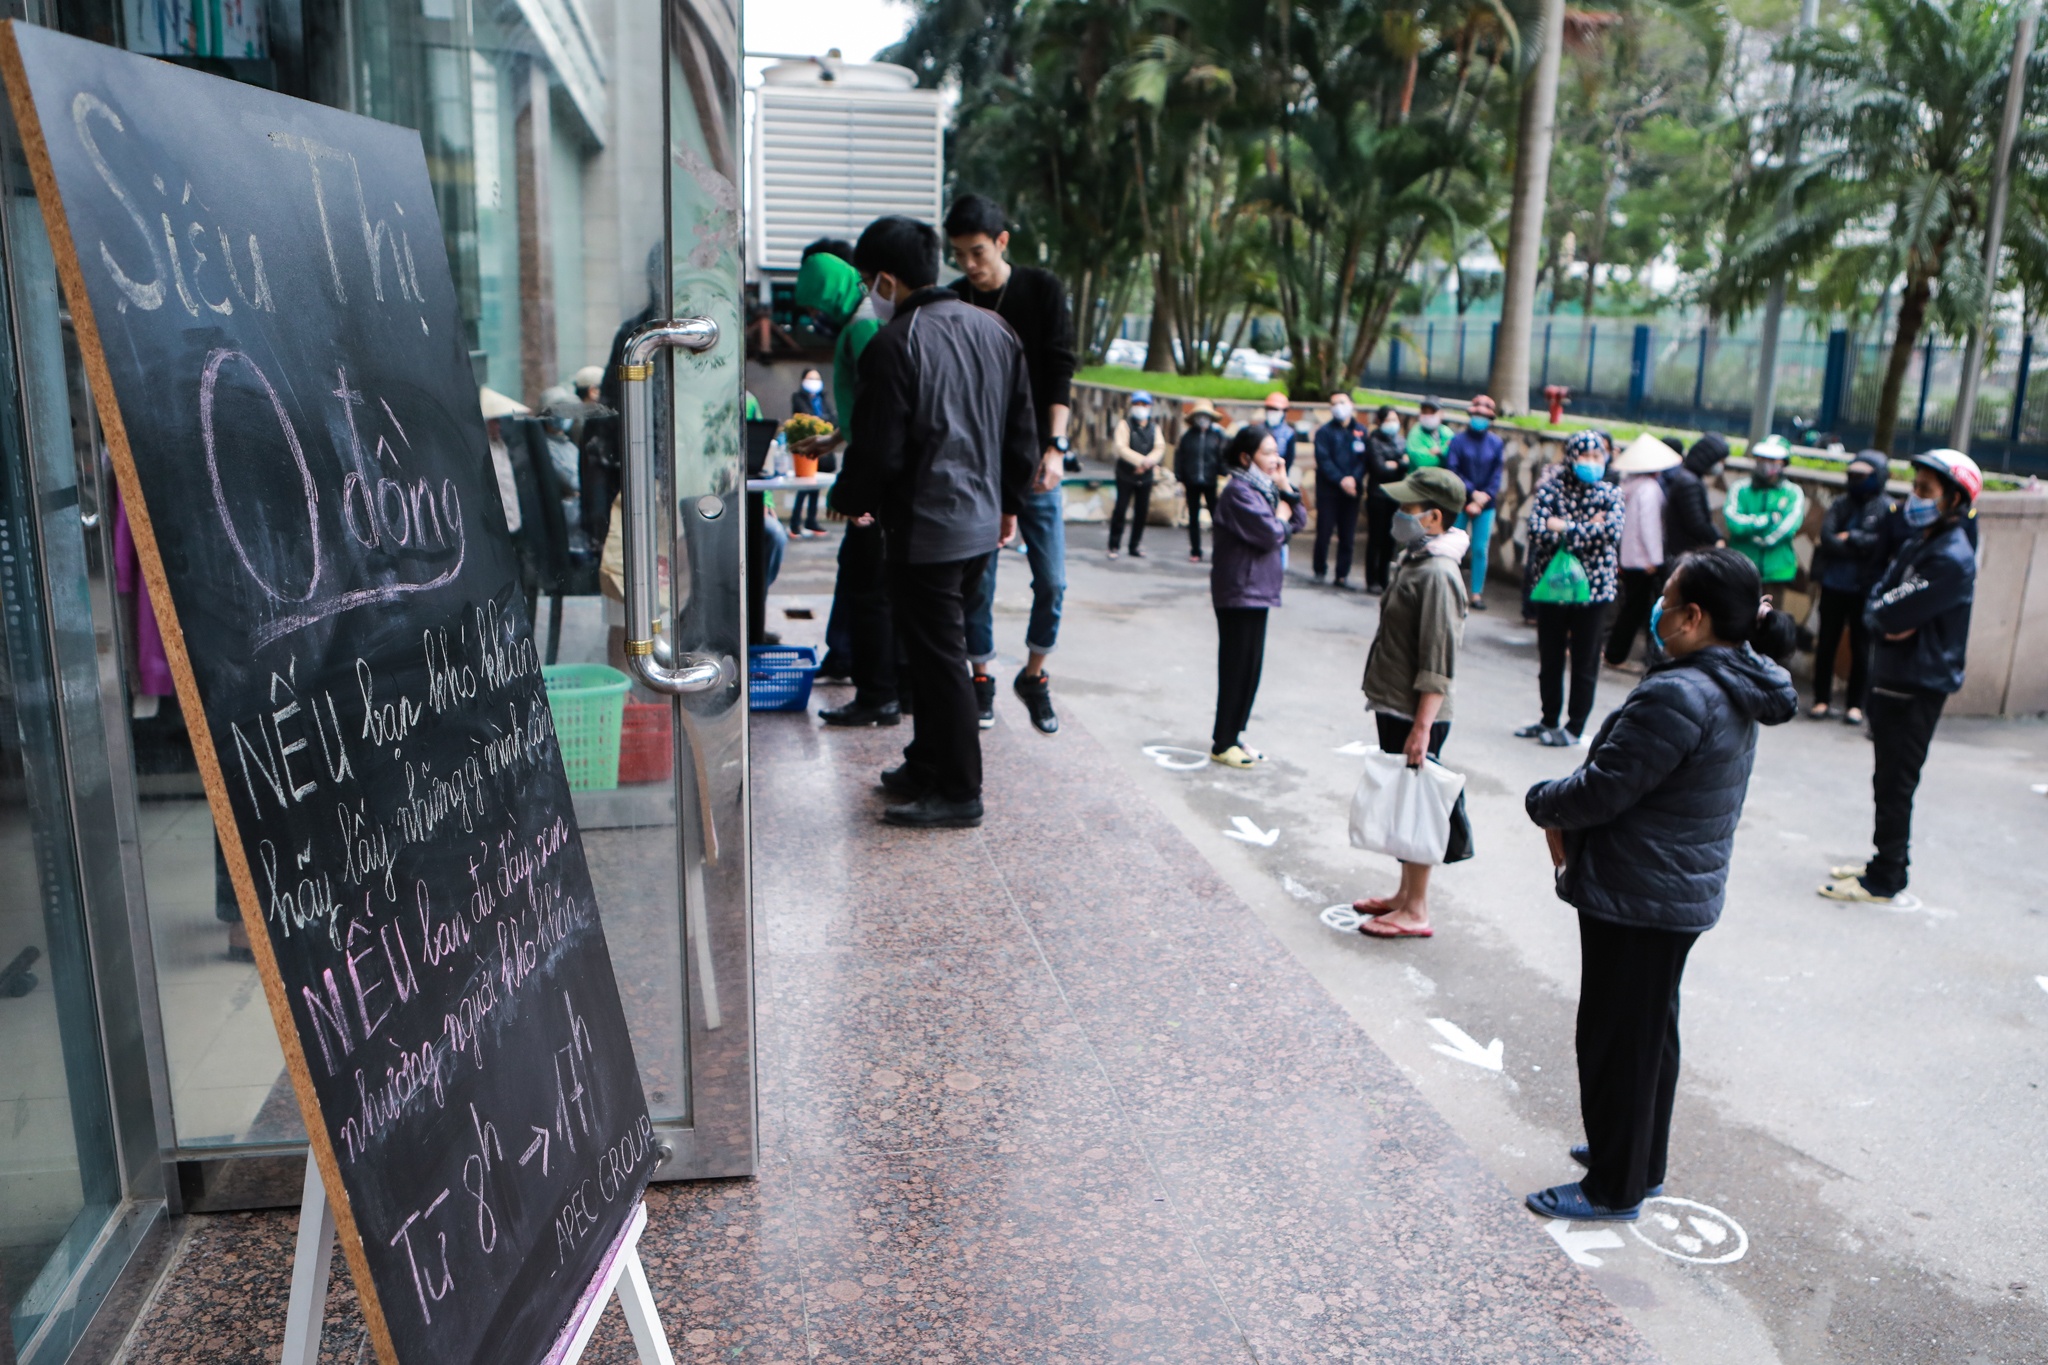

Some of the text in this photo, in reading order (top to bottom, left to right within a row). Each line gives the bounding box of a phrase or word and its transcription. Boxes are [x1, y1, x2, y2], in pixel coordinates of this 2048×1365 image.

[72, 91, 430, 337] Siêu Thị
[231, 599, 538, 820] NẾU bạn khó khăn
[260, 837, 342, 951] hãy
[337, 798, 397, 902] lấy
[397, 761, 473, 843] những
[465, 736, 485, 815] gì
[484, 702, 528, 775] mình
[302, 889, 419, 1077] NẾU
[416, 879, 470, 973] bạn
[468, 840, 496, 923] đủ
[340, 1037, 445, 1163] nhường
[444, 953, 497, 1069] người
[497, 908, 537, 996] khó
[463, 1102, 502, 1254] 8h
